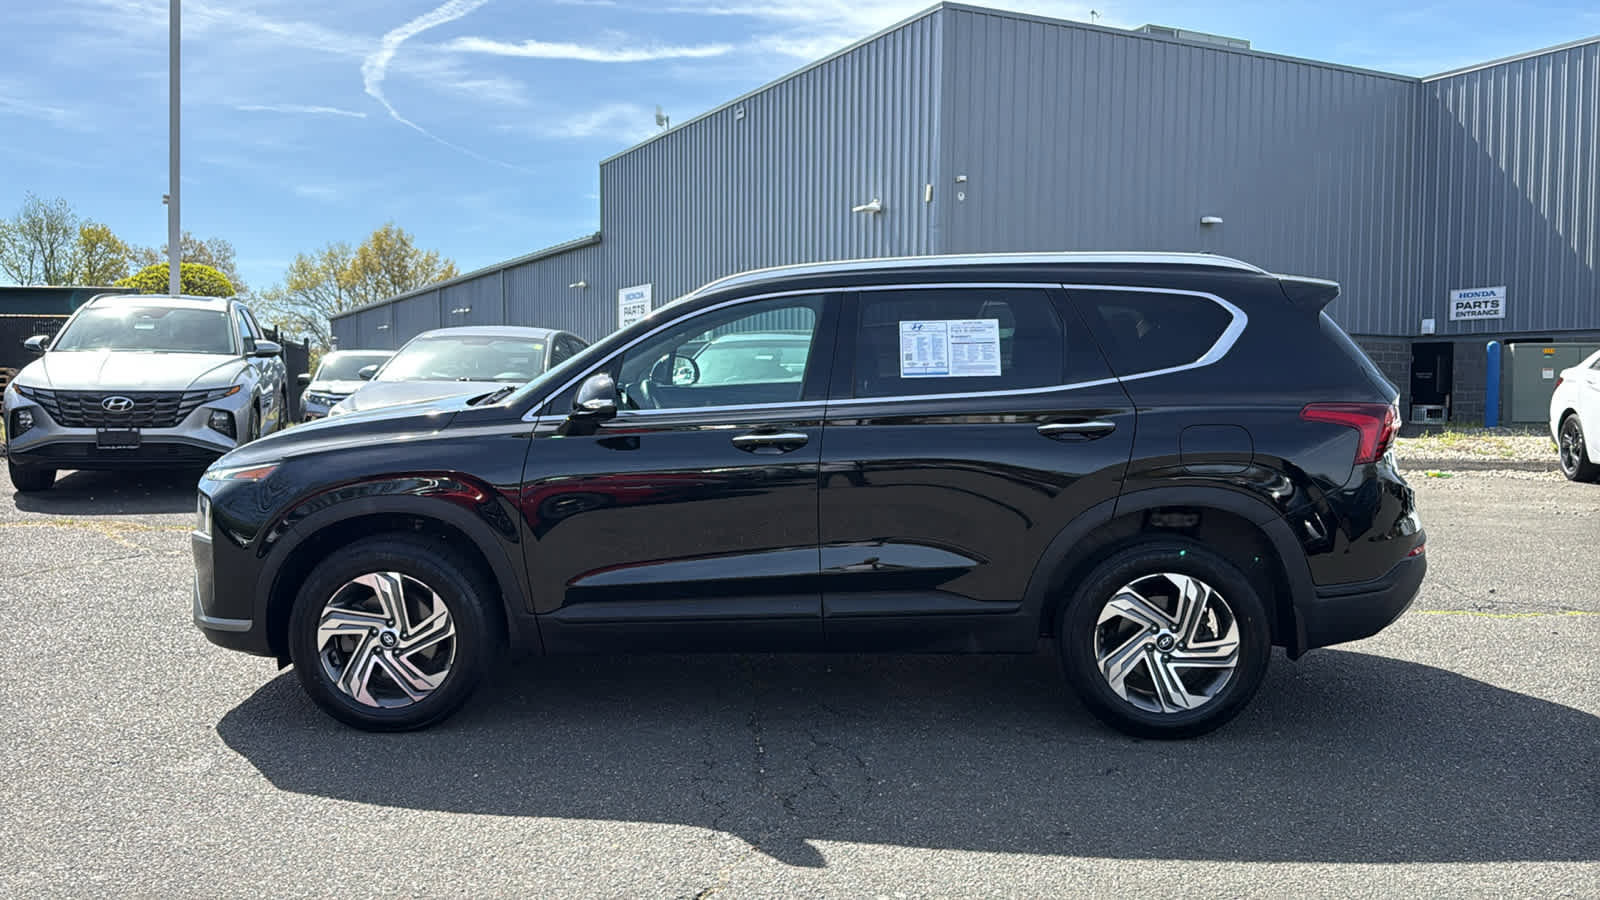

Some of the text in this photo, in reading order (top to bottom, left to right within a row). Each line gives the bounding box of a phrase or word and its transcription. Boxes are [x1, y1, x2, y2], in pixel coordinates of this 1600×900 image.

[1459, 290, 1496, 298] HONDA
[1456, 300, 1500, 310] PARTS
[624, 304, 646, 316] PARTS
[1456, 309, 1500, 318] ENTRANCE
